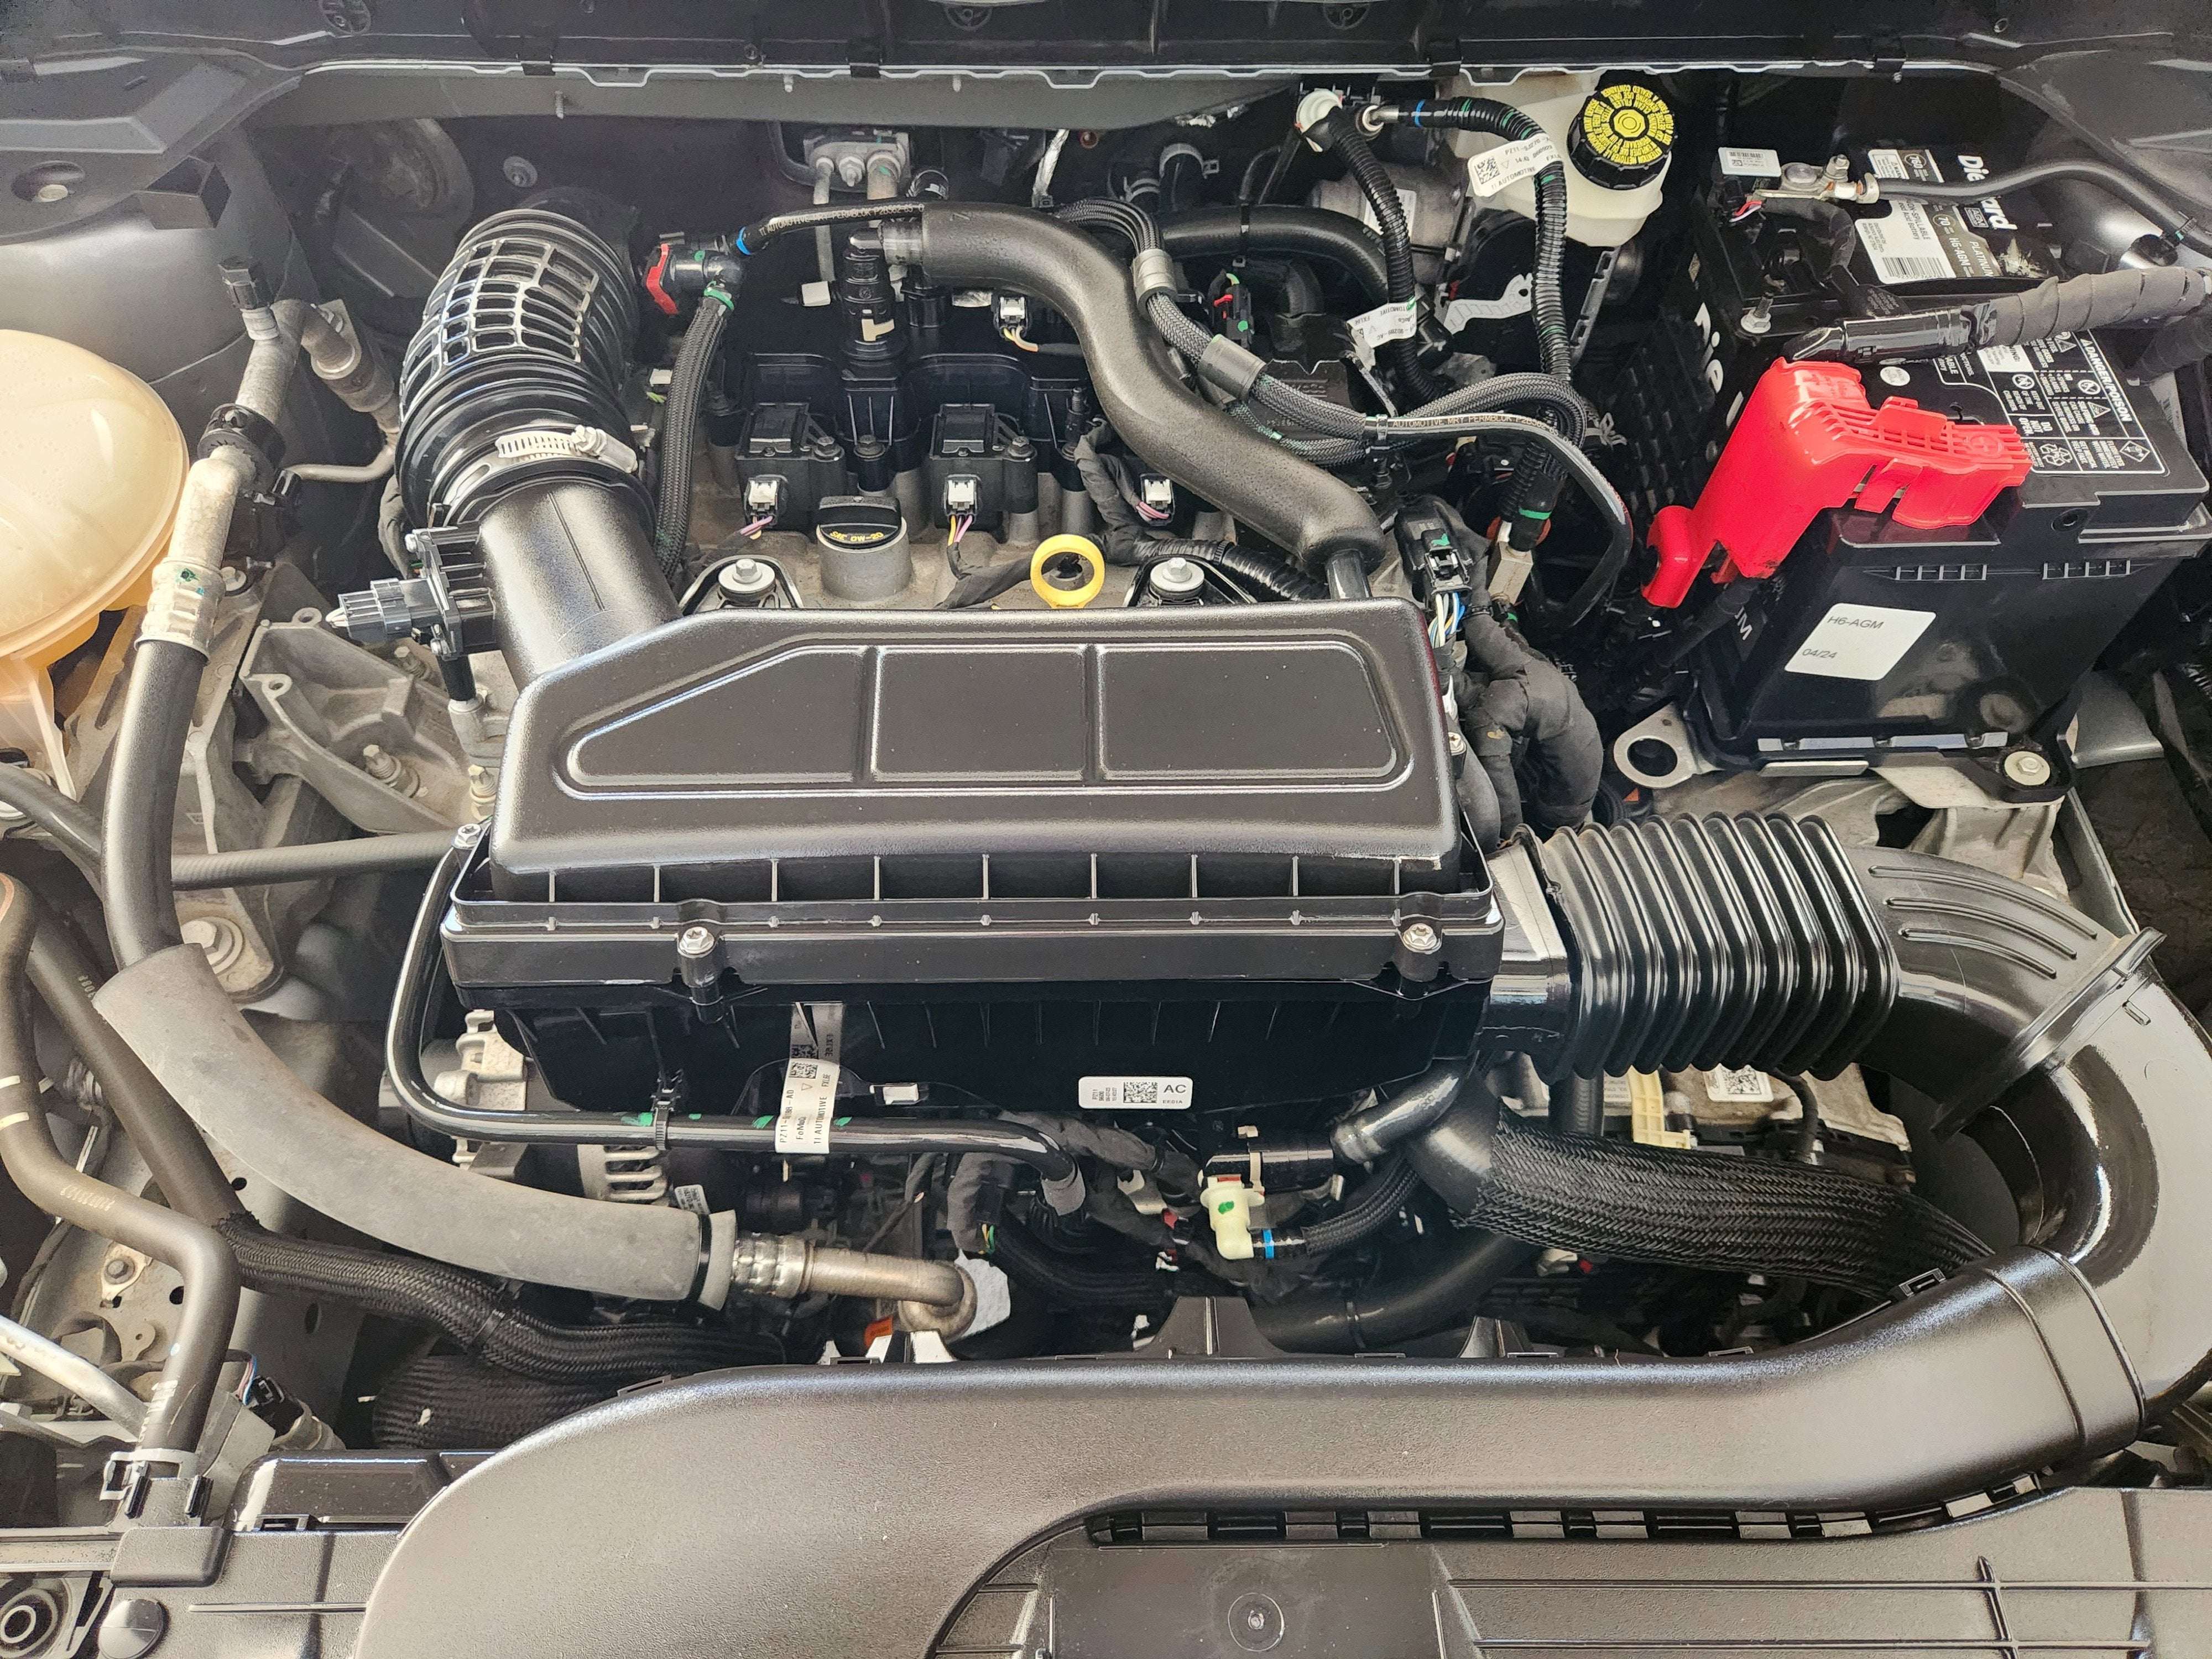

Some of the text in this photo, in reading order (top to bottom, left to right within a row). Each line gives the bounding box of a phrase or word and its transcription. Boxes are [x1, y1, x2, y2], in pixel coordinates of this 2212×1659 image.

[1938, 216, 1951, 226] 70
[1971, 209, 1986, 227] AGM
[766, 216, 810, 234] AUTOMOTIVE
[1902, 211, 1912, 223] Acid
[1908, 222, 1921, 240] Battery
[2084, 346, 2132, 421] DANGER/POISON
[1392, 419, 1445, 427] AUTOMOTIVE
[1447, 416, 1464, 424] MRY
[2029, 420, 2043, 432] NOT
[2041, 422, 2053, 430] DO
[830, 531, 884, 542] SAE 0W-20
[1827, 615, 1885, 629] H6-AGM
[1802, 648, 1838, 659] 04/24
[1164, 1084, 1187, 1094] AC
[813, 1095, 827, 1144] TI AUTOMOTIVE
